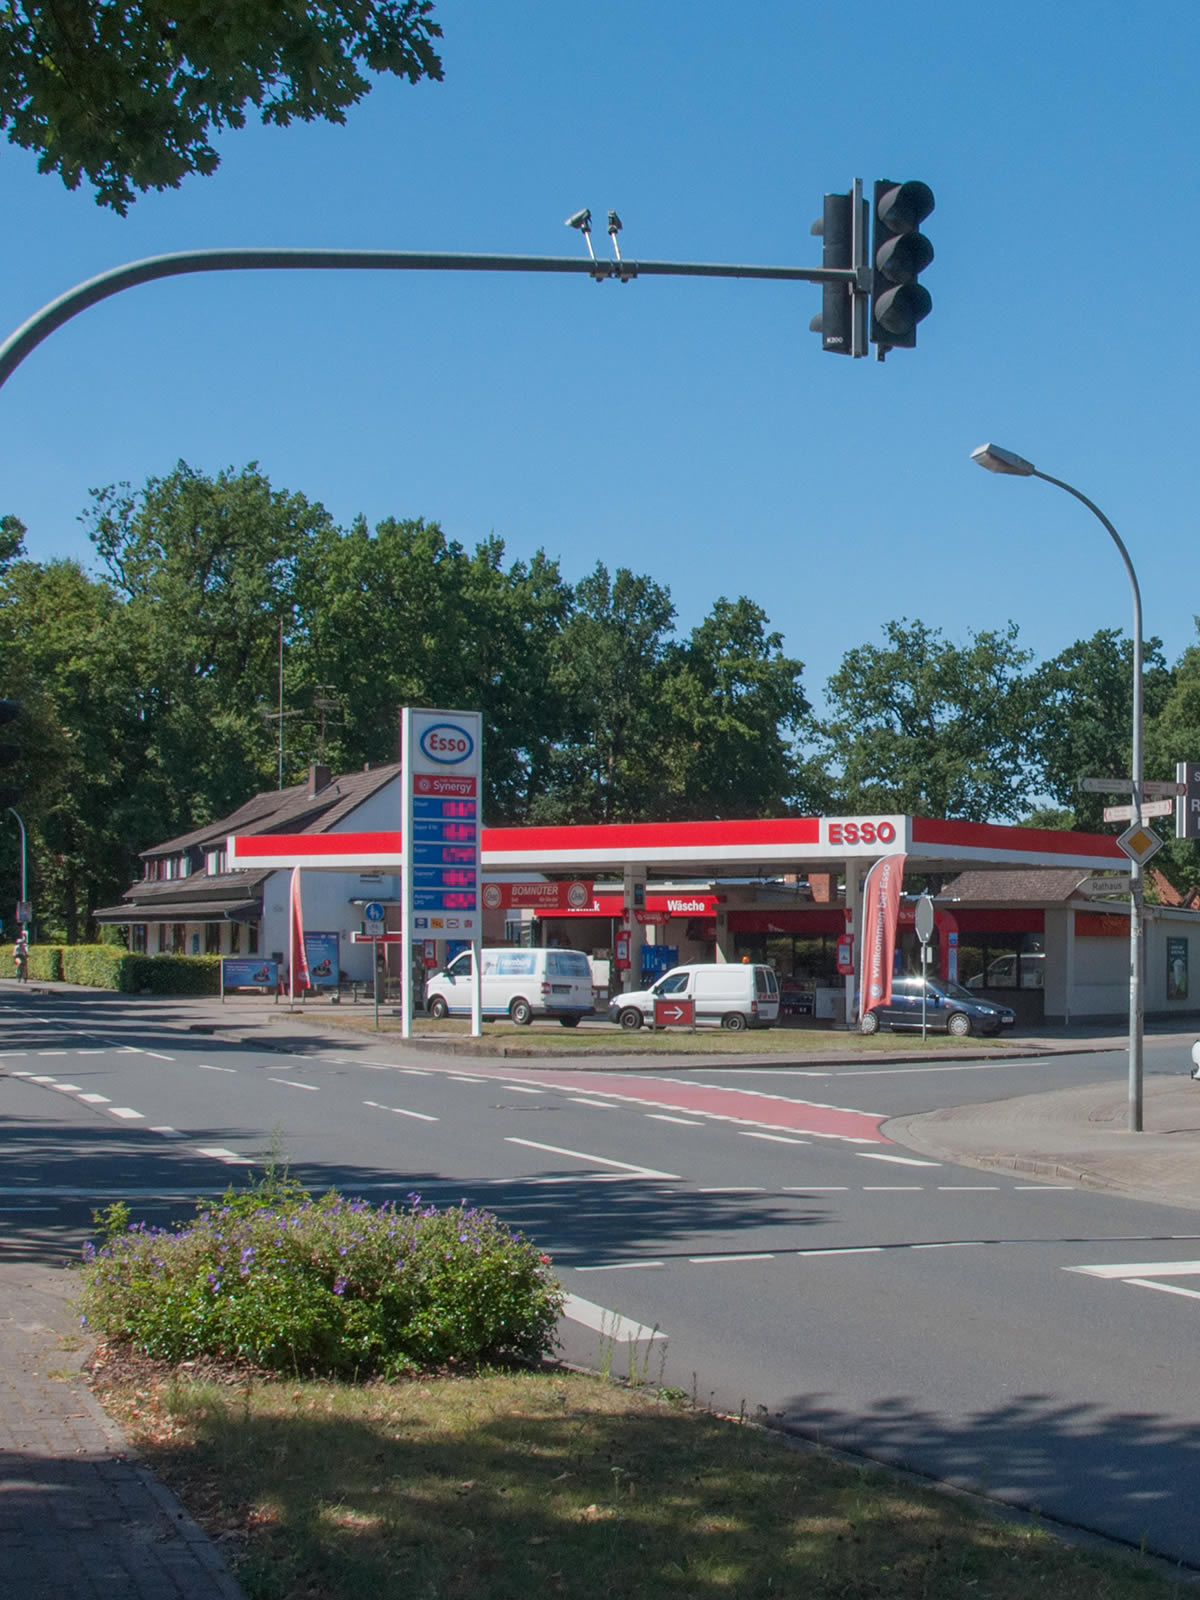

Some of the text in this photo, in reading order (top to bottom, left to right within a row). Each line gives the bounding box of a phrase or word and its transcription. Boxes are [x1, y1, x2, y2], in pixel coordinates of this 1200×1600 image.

[429, 733, 467, 752] Esso
[433, 780, 472, 794] Synergy
[828, 821, 896, 844] ESSO
[1092, 881, 1122, 891] Rathaus
[667, 899, 705, 912] Wäsche
[872, 911, 885, 978] willkommen
[880, 864, 890, 889] Esso
